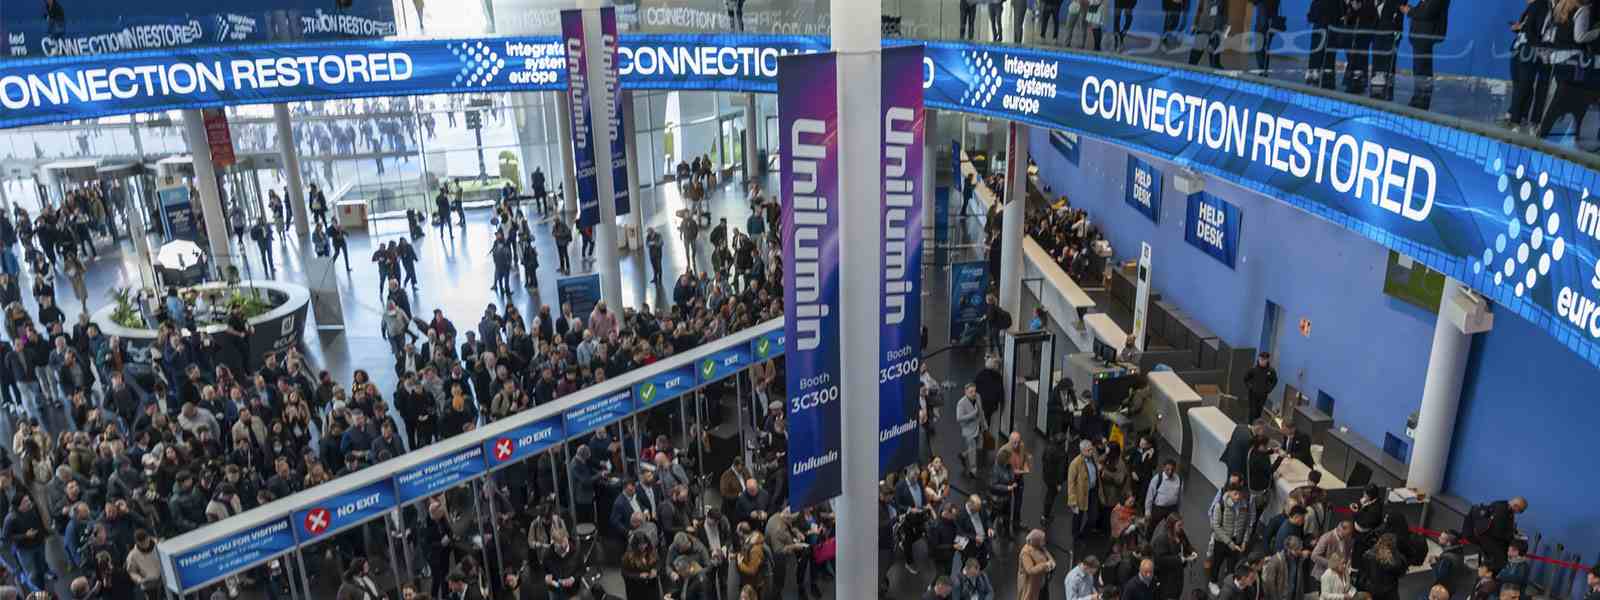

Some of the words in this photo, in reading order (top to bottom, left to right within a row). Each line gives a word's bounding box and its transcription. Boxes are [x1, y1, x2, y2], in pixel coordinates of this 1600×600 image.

[505, 40, 566, 58] integrate
[617, 46, 778, 77] CONNECTIO
[508, 71, 558, 85] europe
[1004, 54, 1059, 80] integrated
[0, 62, 226, 110] ONNECTION
[231, 52, 413, 90] RESTORED
[567, 37, 589, 149] Unilumin
[1016, 78, 1058, 99] systems
[1003, 94, 1040, 115] europe
[1081, 75, 1249, 157] CONNECTION
[1251, 111, 1437, 223] RESTORED
[1134, 167, 1152, 190] HELP
[1133, 183, 1152, 208] DESK
[885, 106, 914, 325] Unilumin
[1199, 201, 1225, 228] HELP
[791, 118, 830, 351] Unilumin
[1196, 219, 1224, 250] DESK
[1557, 286, 1600, 338] euro
[723, 353, 739, 366] EXIT
[887, 345, 912, 361] Booth
[665, 376, 681, 390] EXIT
[800, 372, 830, 390] Booth
[879, 357, 918, 384] 3C300
[791, 385, 838, 413] 3C300
[518, 433, 533, 448] NO
[533, 426, 553, 442] EXIT
[880, 417, 917, 442] Unilumin
[792, 450, 838, 475] Unilumin
[336, 503, 356, 519] NO
[357, 492, 380, 511] EXIT
[178, 549, 212, 568] THANK
[214, 542, 232, 555] YOU
[232, 535, 251, 549] FOR
[250, 520, 288, 540] VISITING
